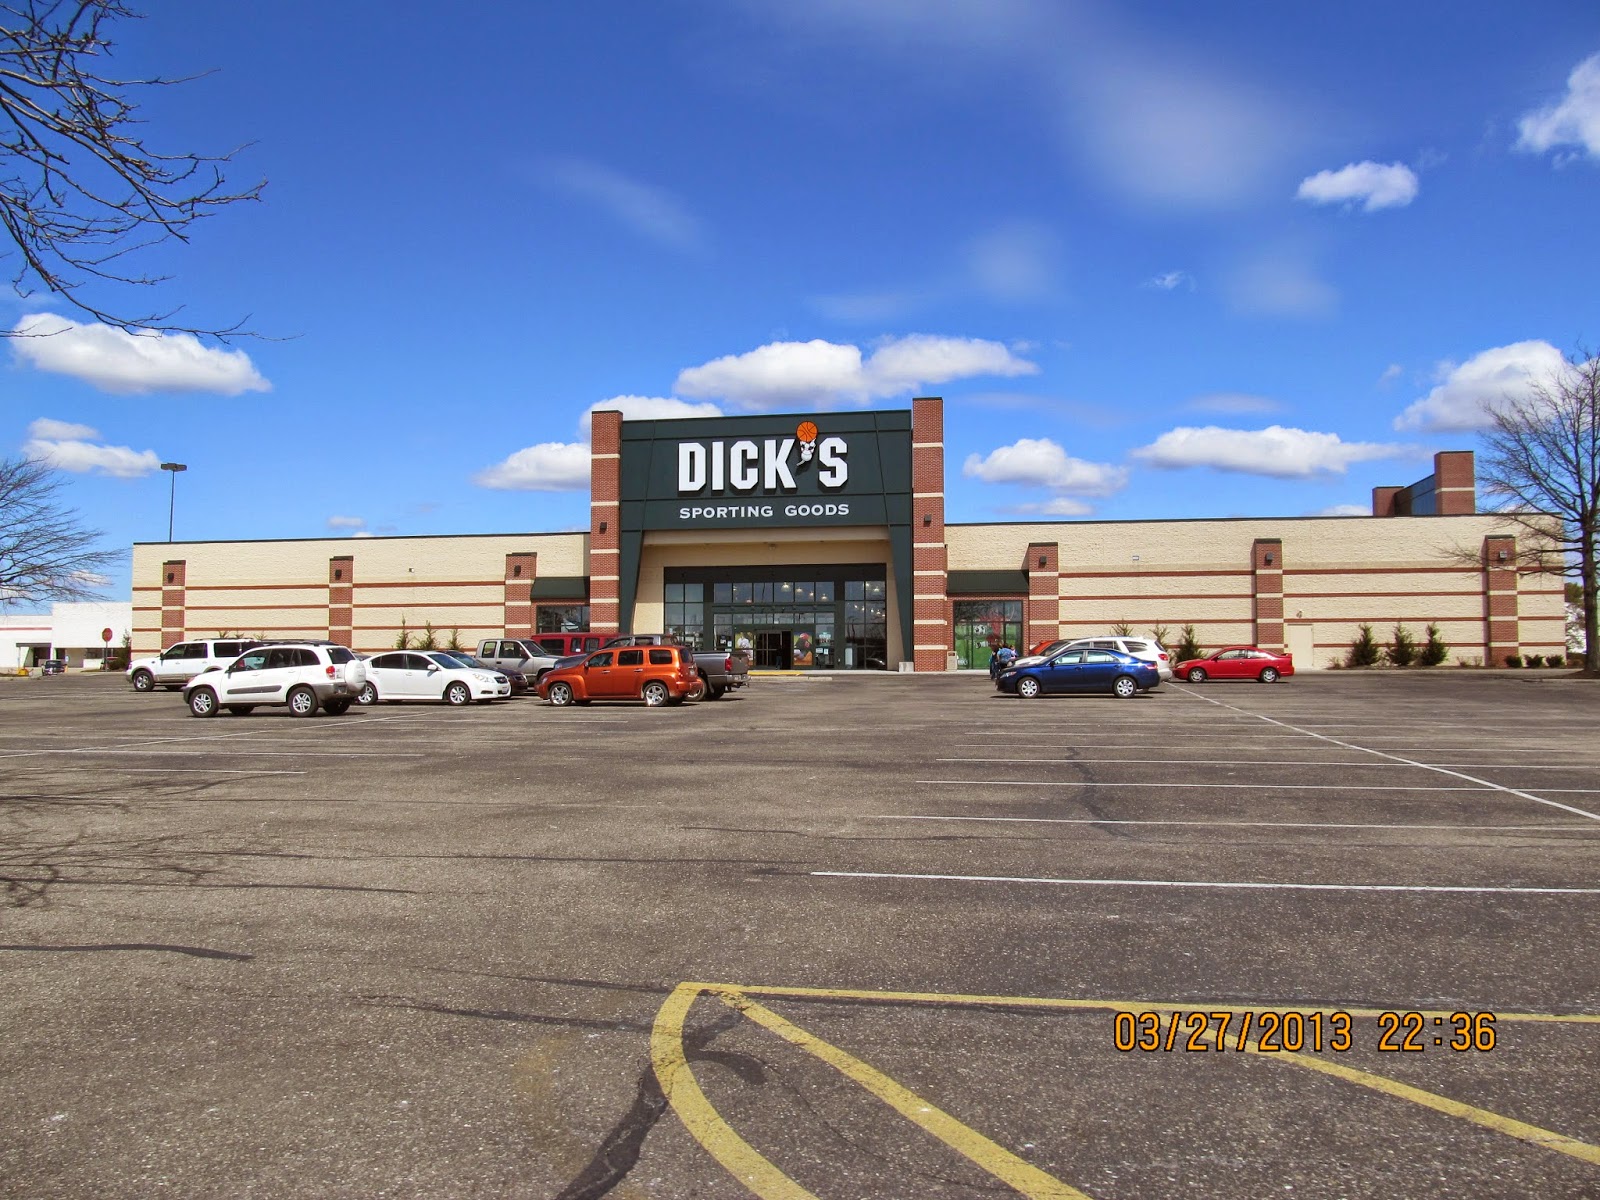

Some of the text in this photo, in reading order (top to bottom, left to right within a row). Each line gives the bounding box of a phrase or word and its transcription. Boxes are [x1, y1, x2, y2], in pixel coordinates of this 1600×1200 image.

[678, 436, 849, 492] DICK'S
[679, 503, 850, 519] SPORTING GOODS
